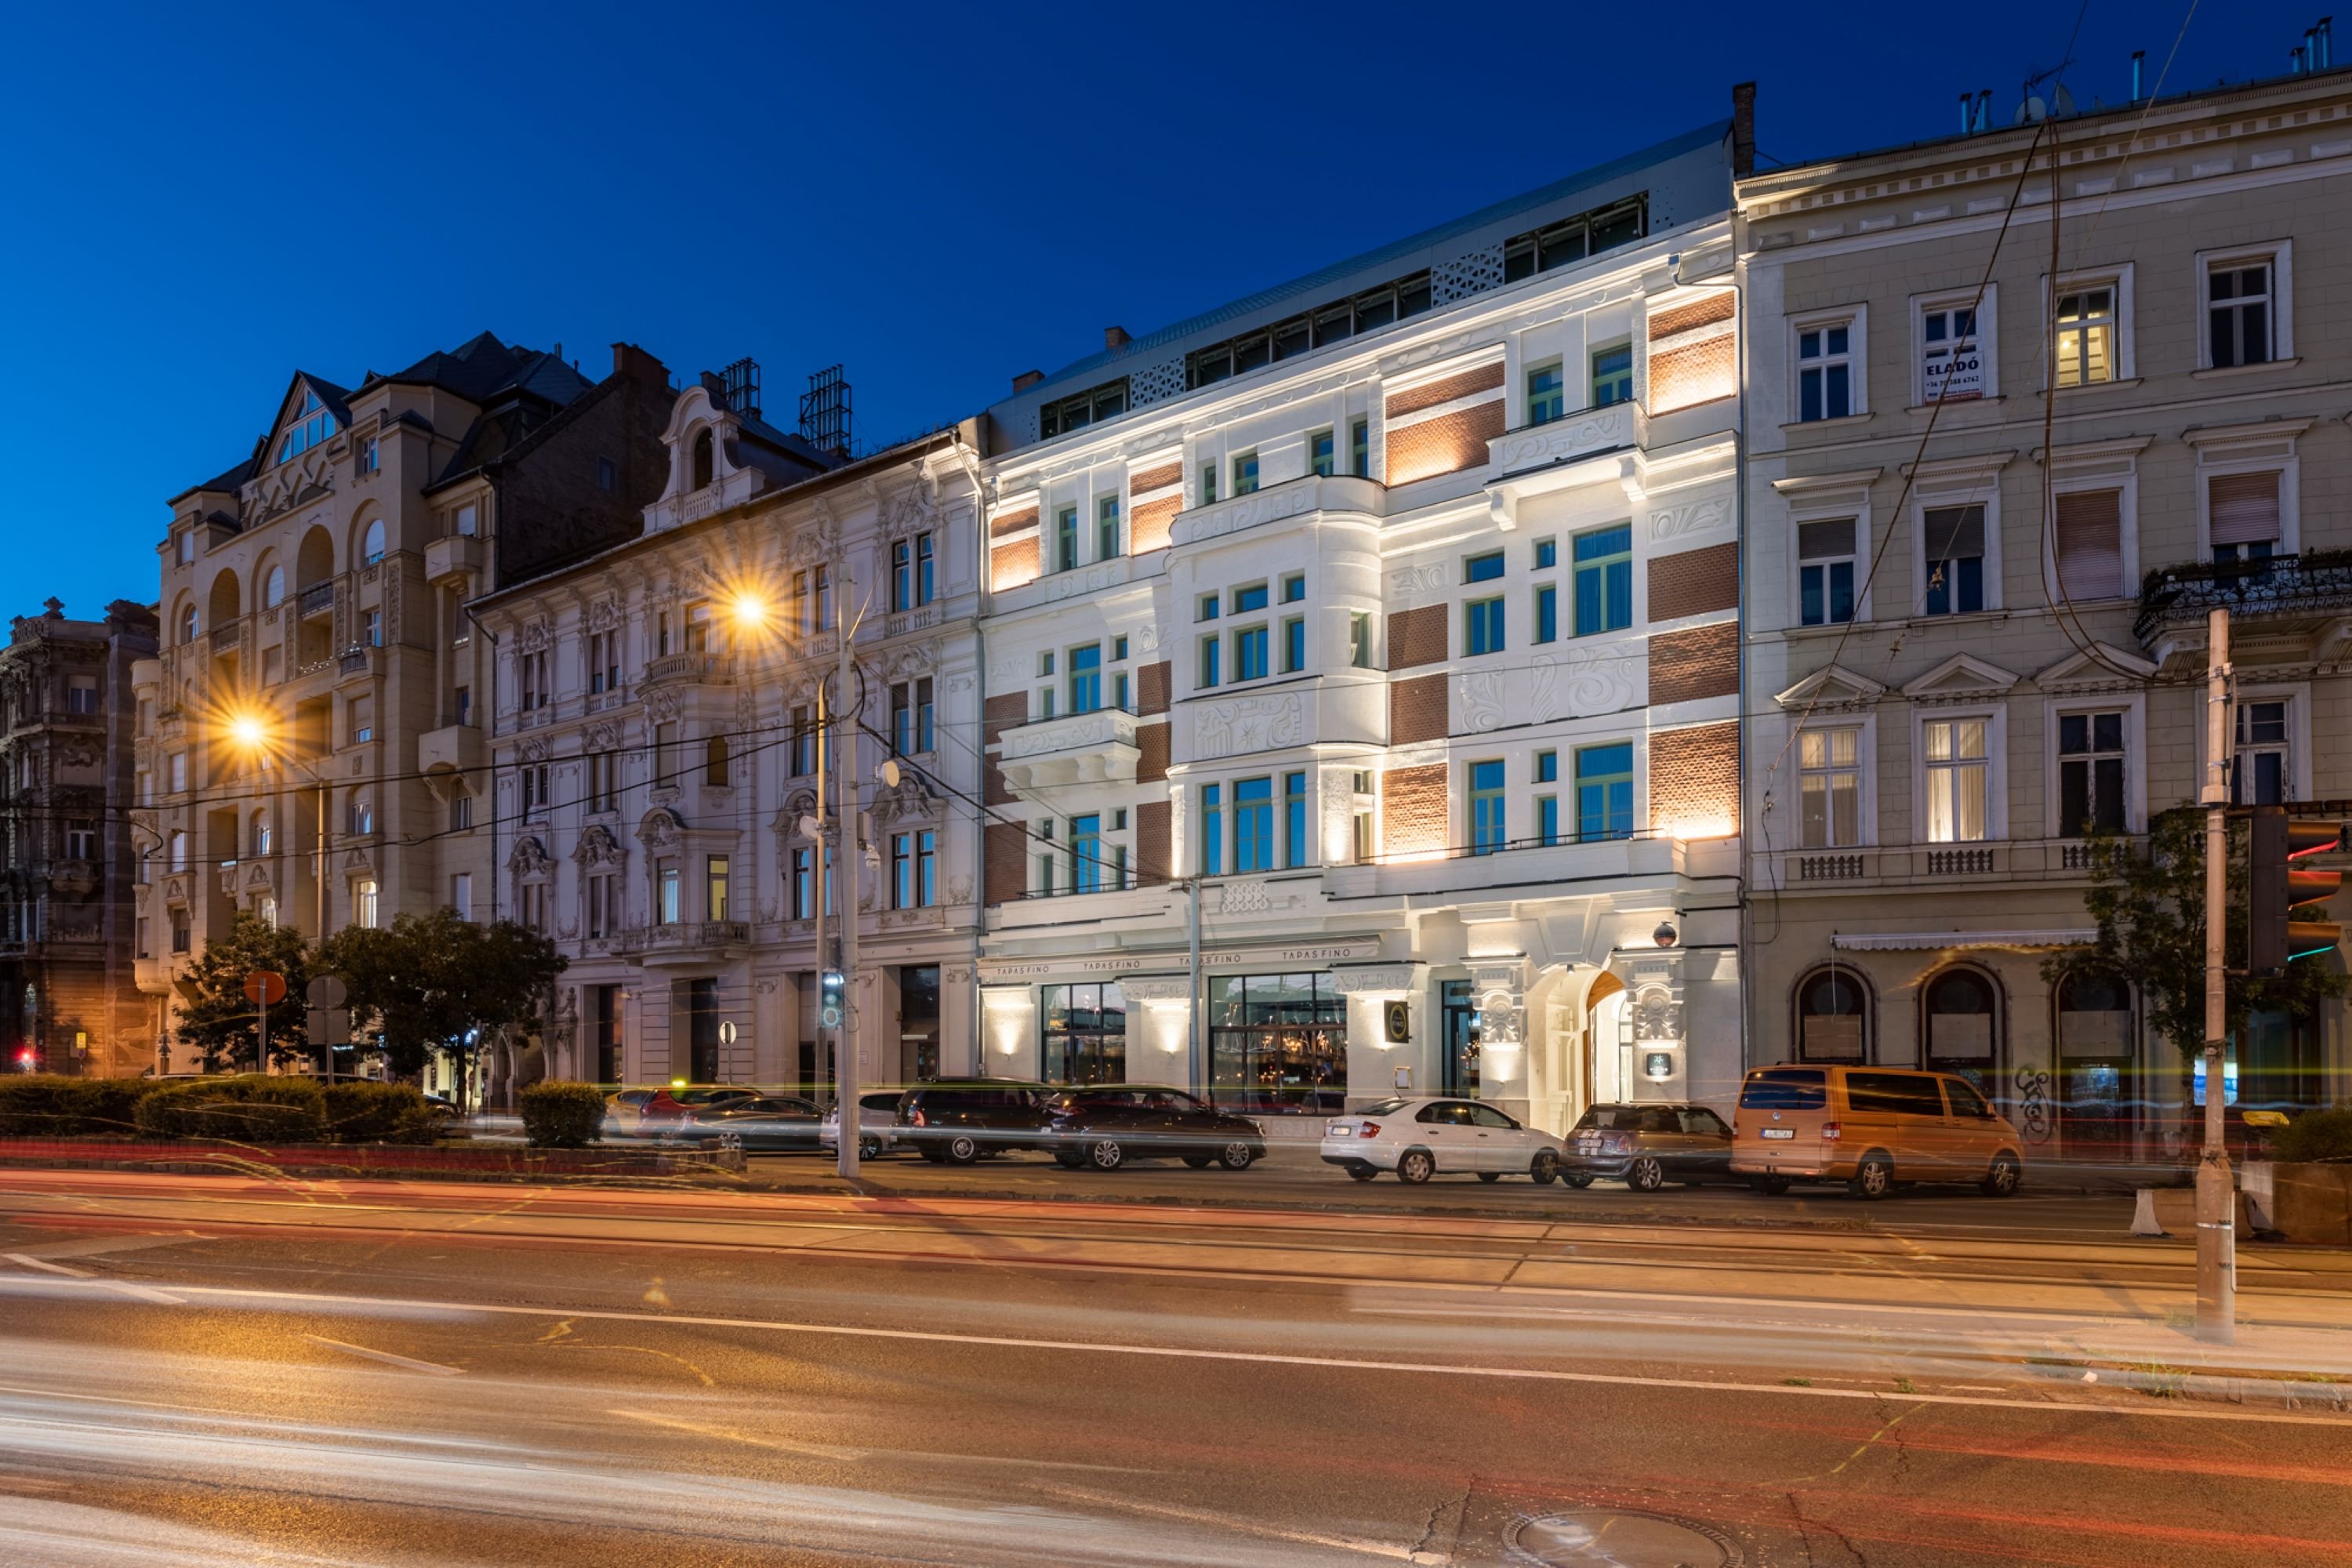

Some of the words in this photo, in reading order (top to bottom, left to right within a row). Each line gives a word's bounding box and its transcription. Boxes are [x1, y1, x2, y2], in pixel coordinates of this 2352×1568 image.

[1283, 950, 1317, 960] TAPAS
[1321, 948, 1351, 958] FINO
[1083, 961, 1113, 971] TAPAS
[1116, 960, 1140, 969] FINO
[1179, 956, 1212, 966] TAAS
[1214, 954, 1241, 964] FINO
[997, 967, 1025, 975] TAPAS
[1027, 965, 1049, 974] FINO
